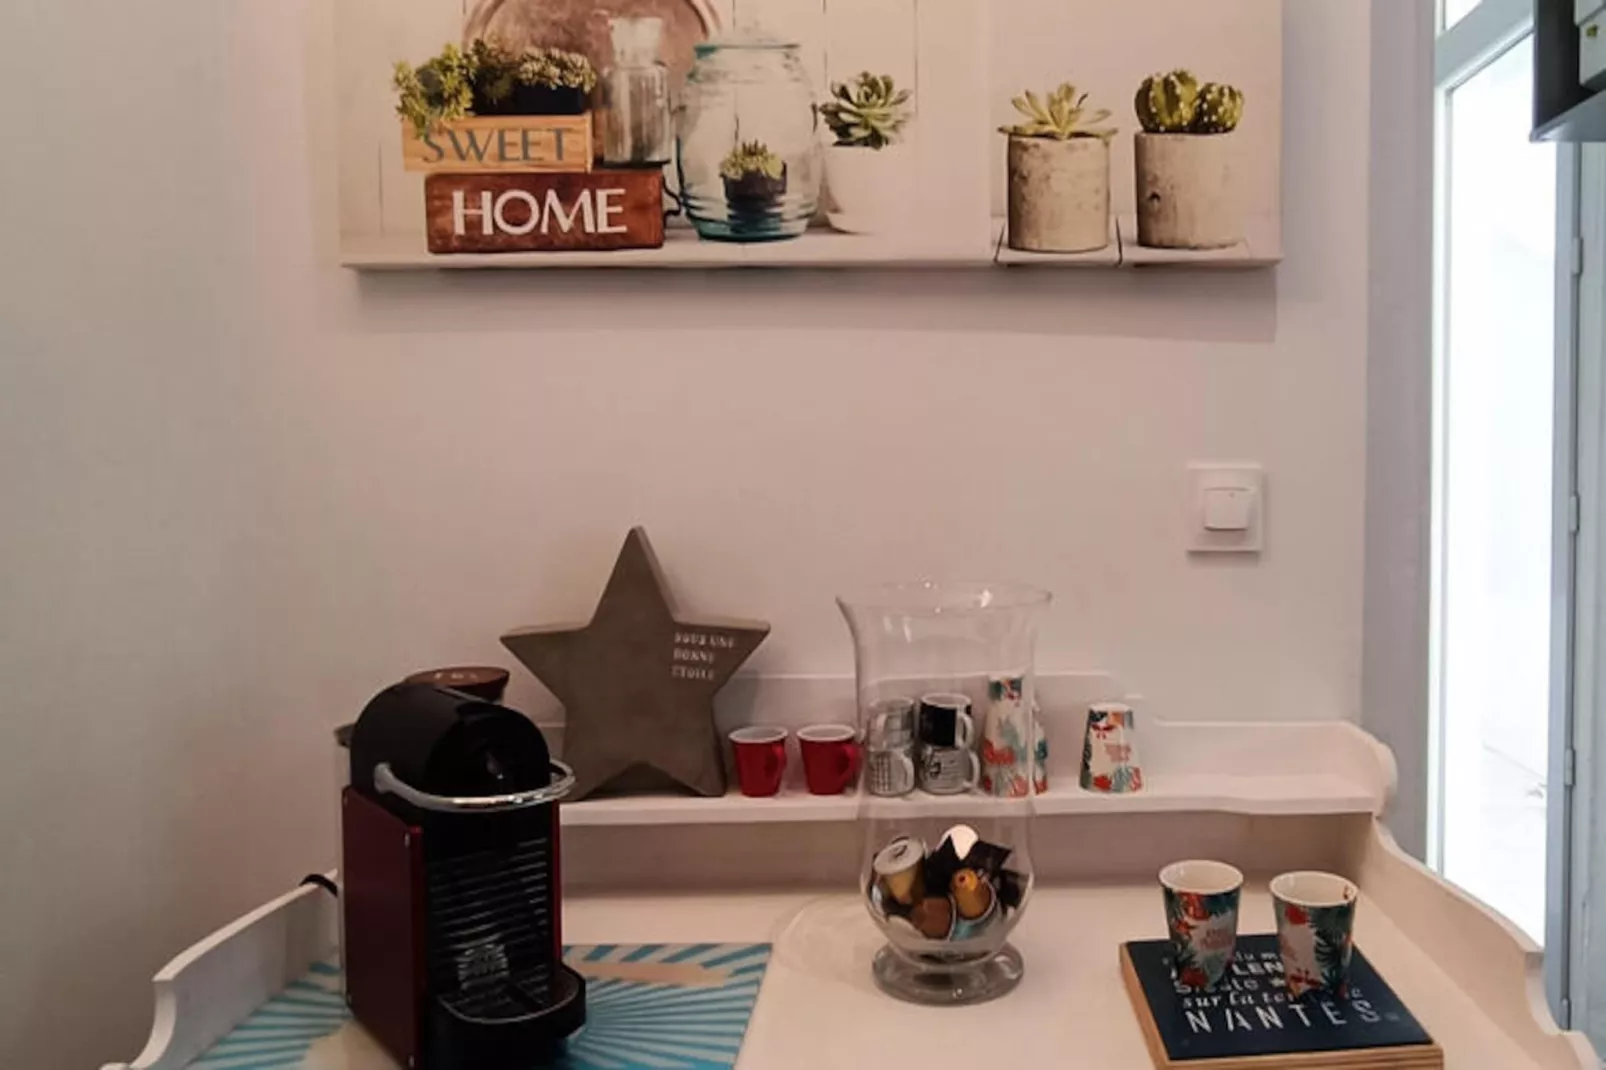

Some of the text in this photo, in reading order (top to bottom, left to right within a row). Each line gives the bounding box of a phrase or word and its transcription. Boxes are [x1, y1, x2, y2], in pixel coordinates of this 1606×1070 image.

[423, 127, 575, 163] SWEET
[452, 188, 628, 236] HOME
[1184, 998, 1383, 1034] NANTES
